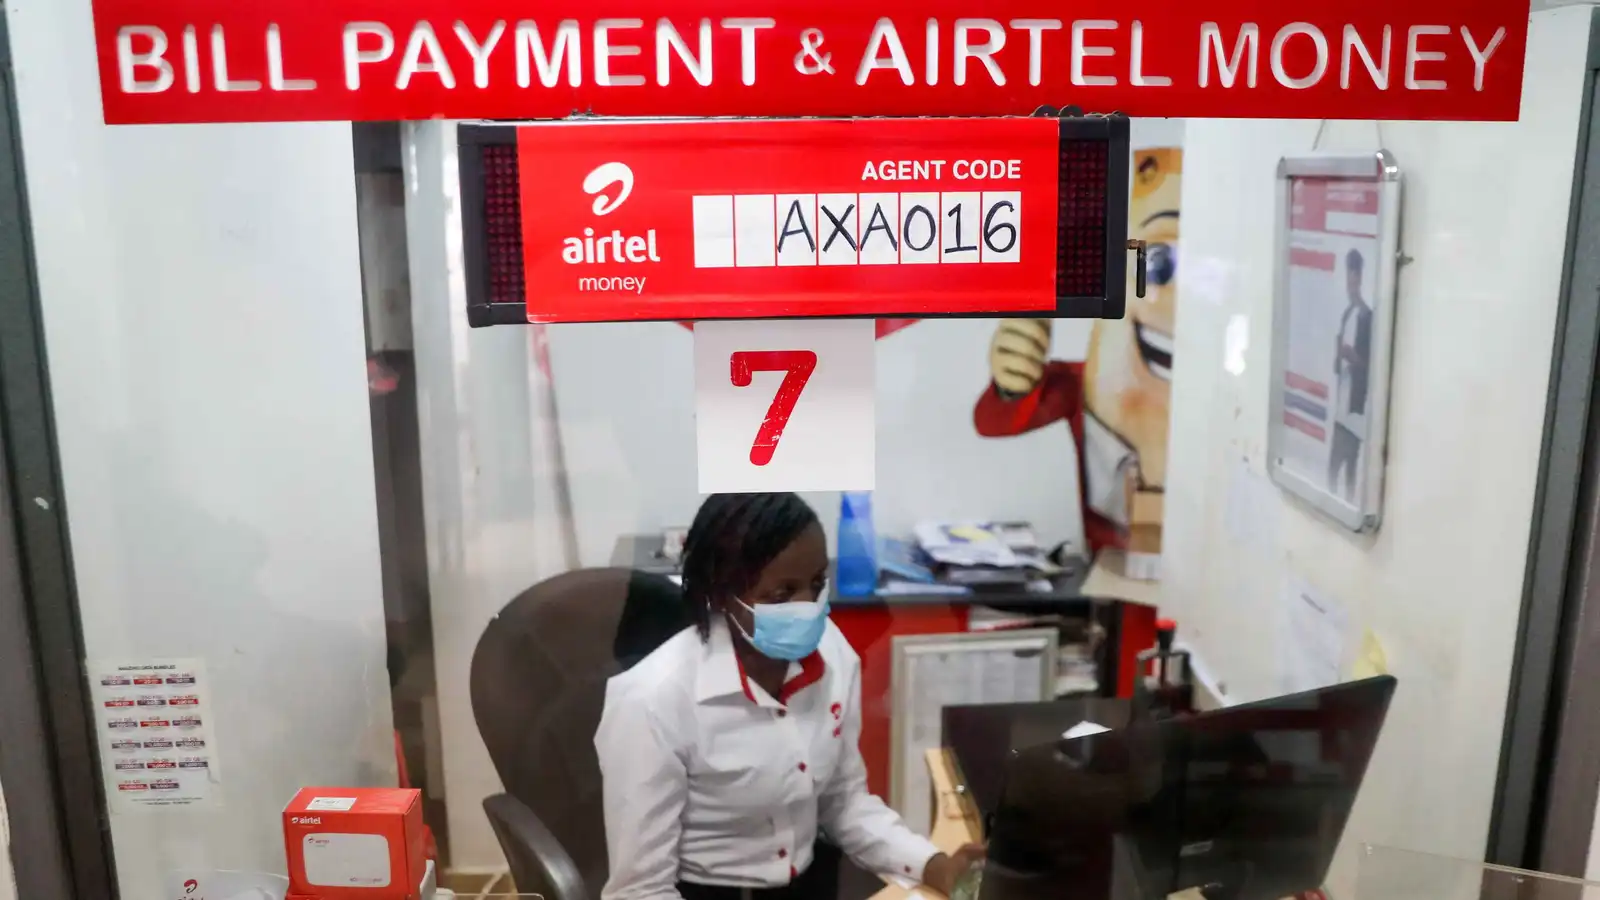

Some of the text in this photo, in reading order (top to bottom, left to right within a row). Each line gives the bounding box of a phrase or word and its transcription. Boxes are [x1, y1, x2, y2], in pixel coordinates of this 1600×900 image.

[117, 17, 1506, 94] BILL PAYMENT & AIRTEL MONEY
[862, 159, 1021, 180] AGENT CODE
[776, 198, 1019, 255] AXA016
[562, 227, 661, 265] airtel
[578, 276, 647, 295] money
[730, 350, 817, 466] 7
[299, 816, 321, 825] airtel
